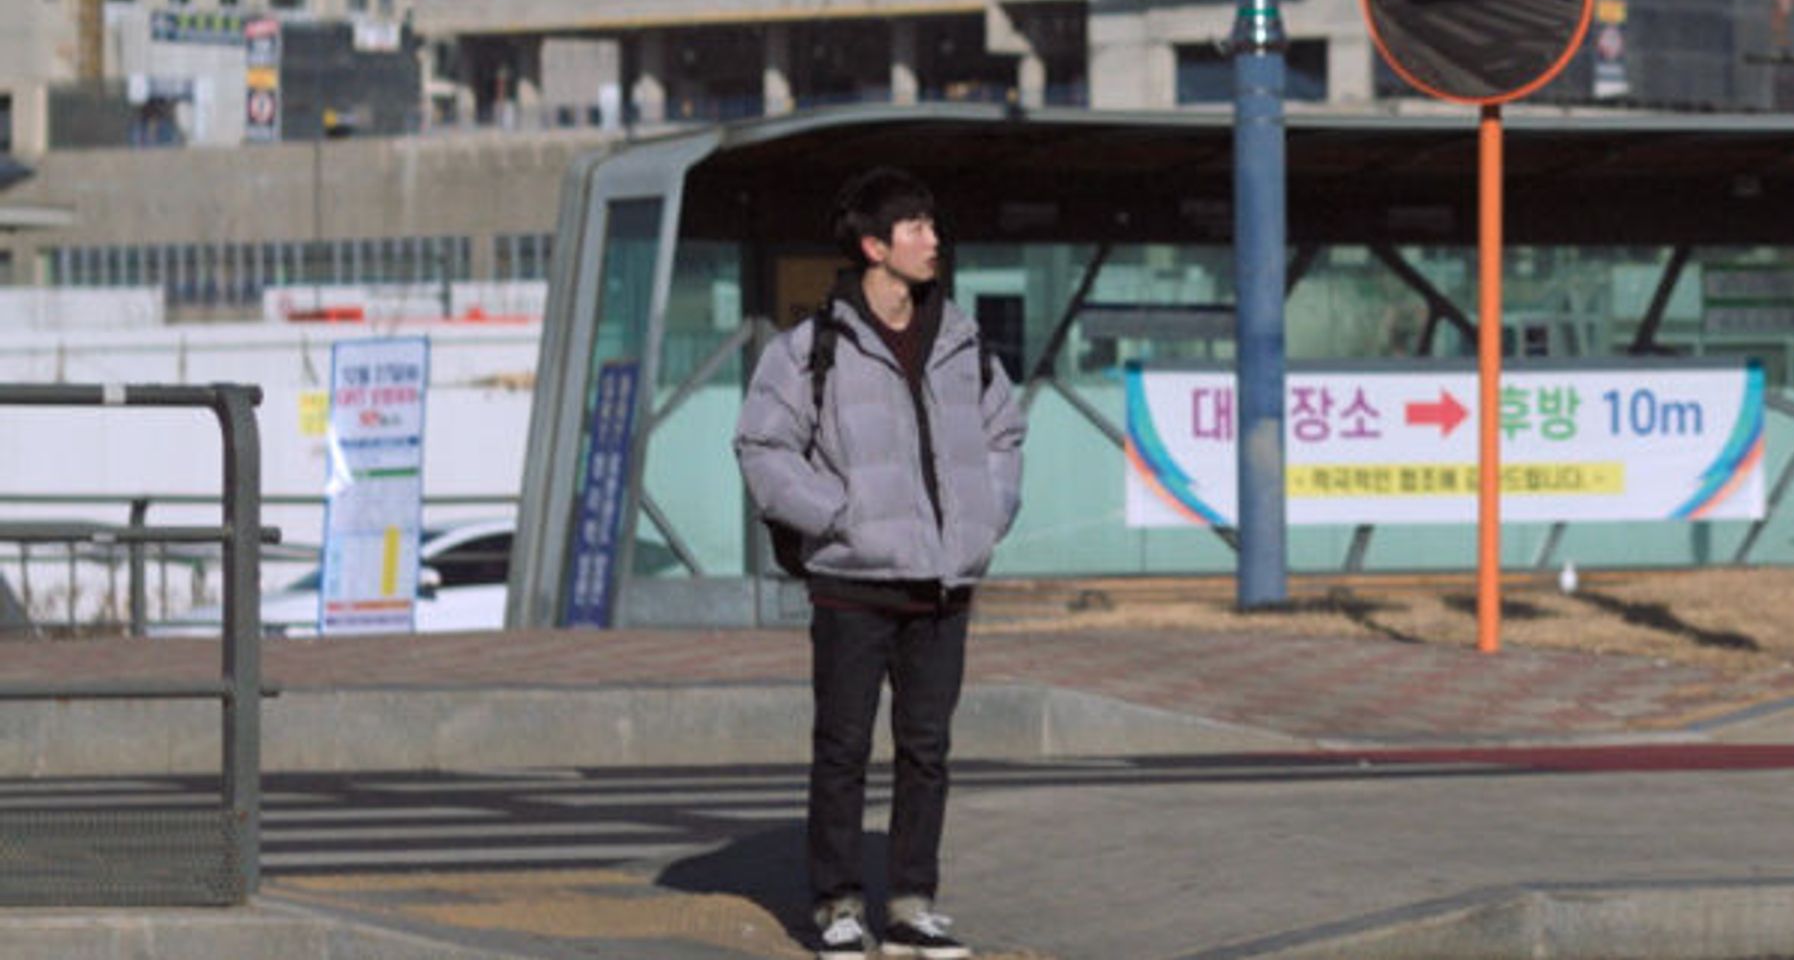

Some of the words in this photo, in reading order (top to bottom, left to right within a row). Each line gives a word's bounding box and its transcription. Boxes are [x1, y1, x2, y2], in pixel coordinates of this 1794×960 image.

[1191, 386, 1383, 442] 대장소
[1499, 386, 1581, 440] 후방
[1603, 389, 1704, 435] 10m
